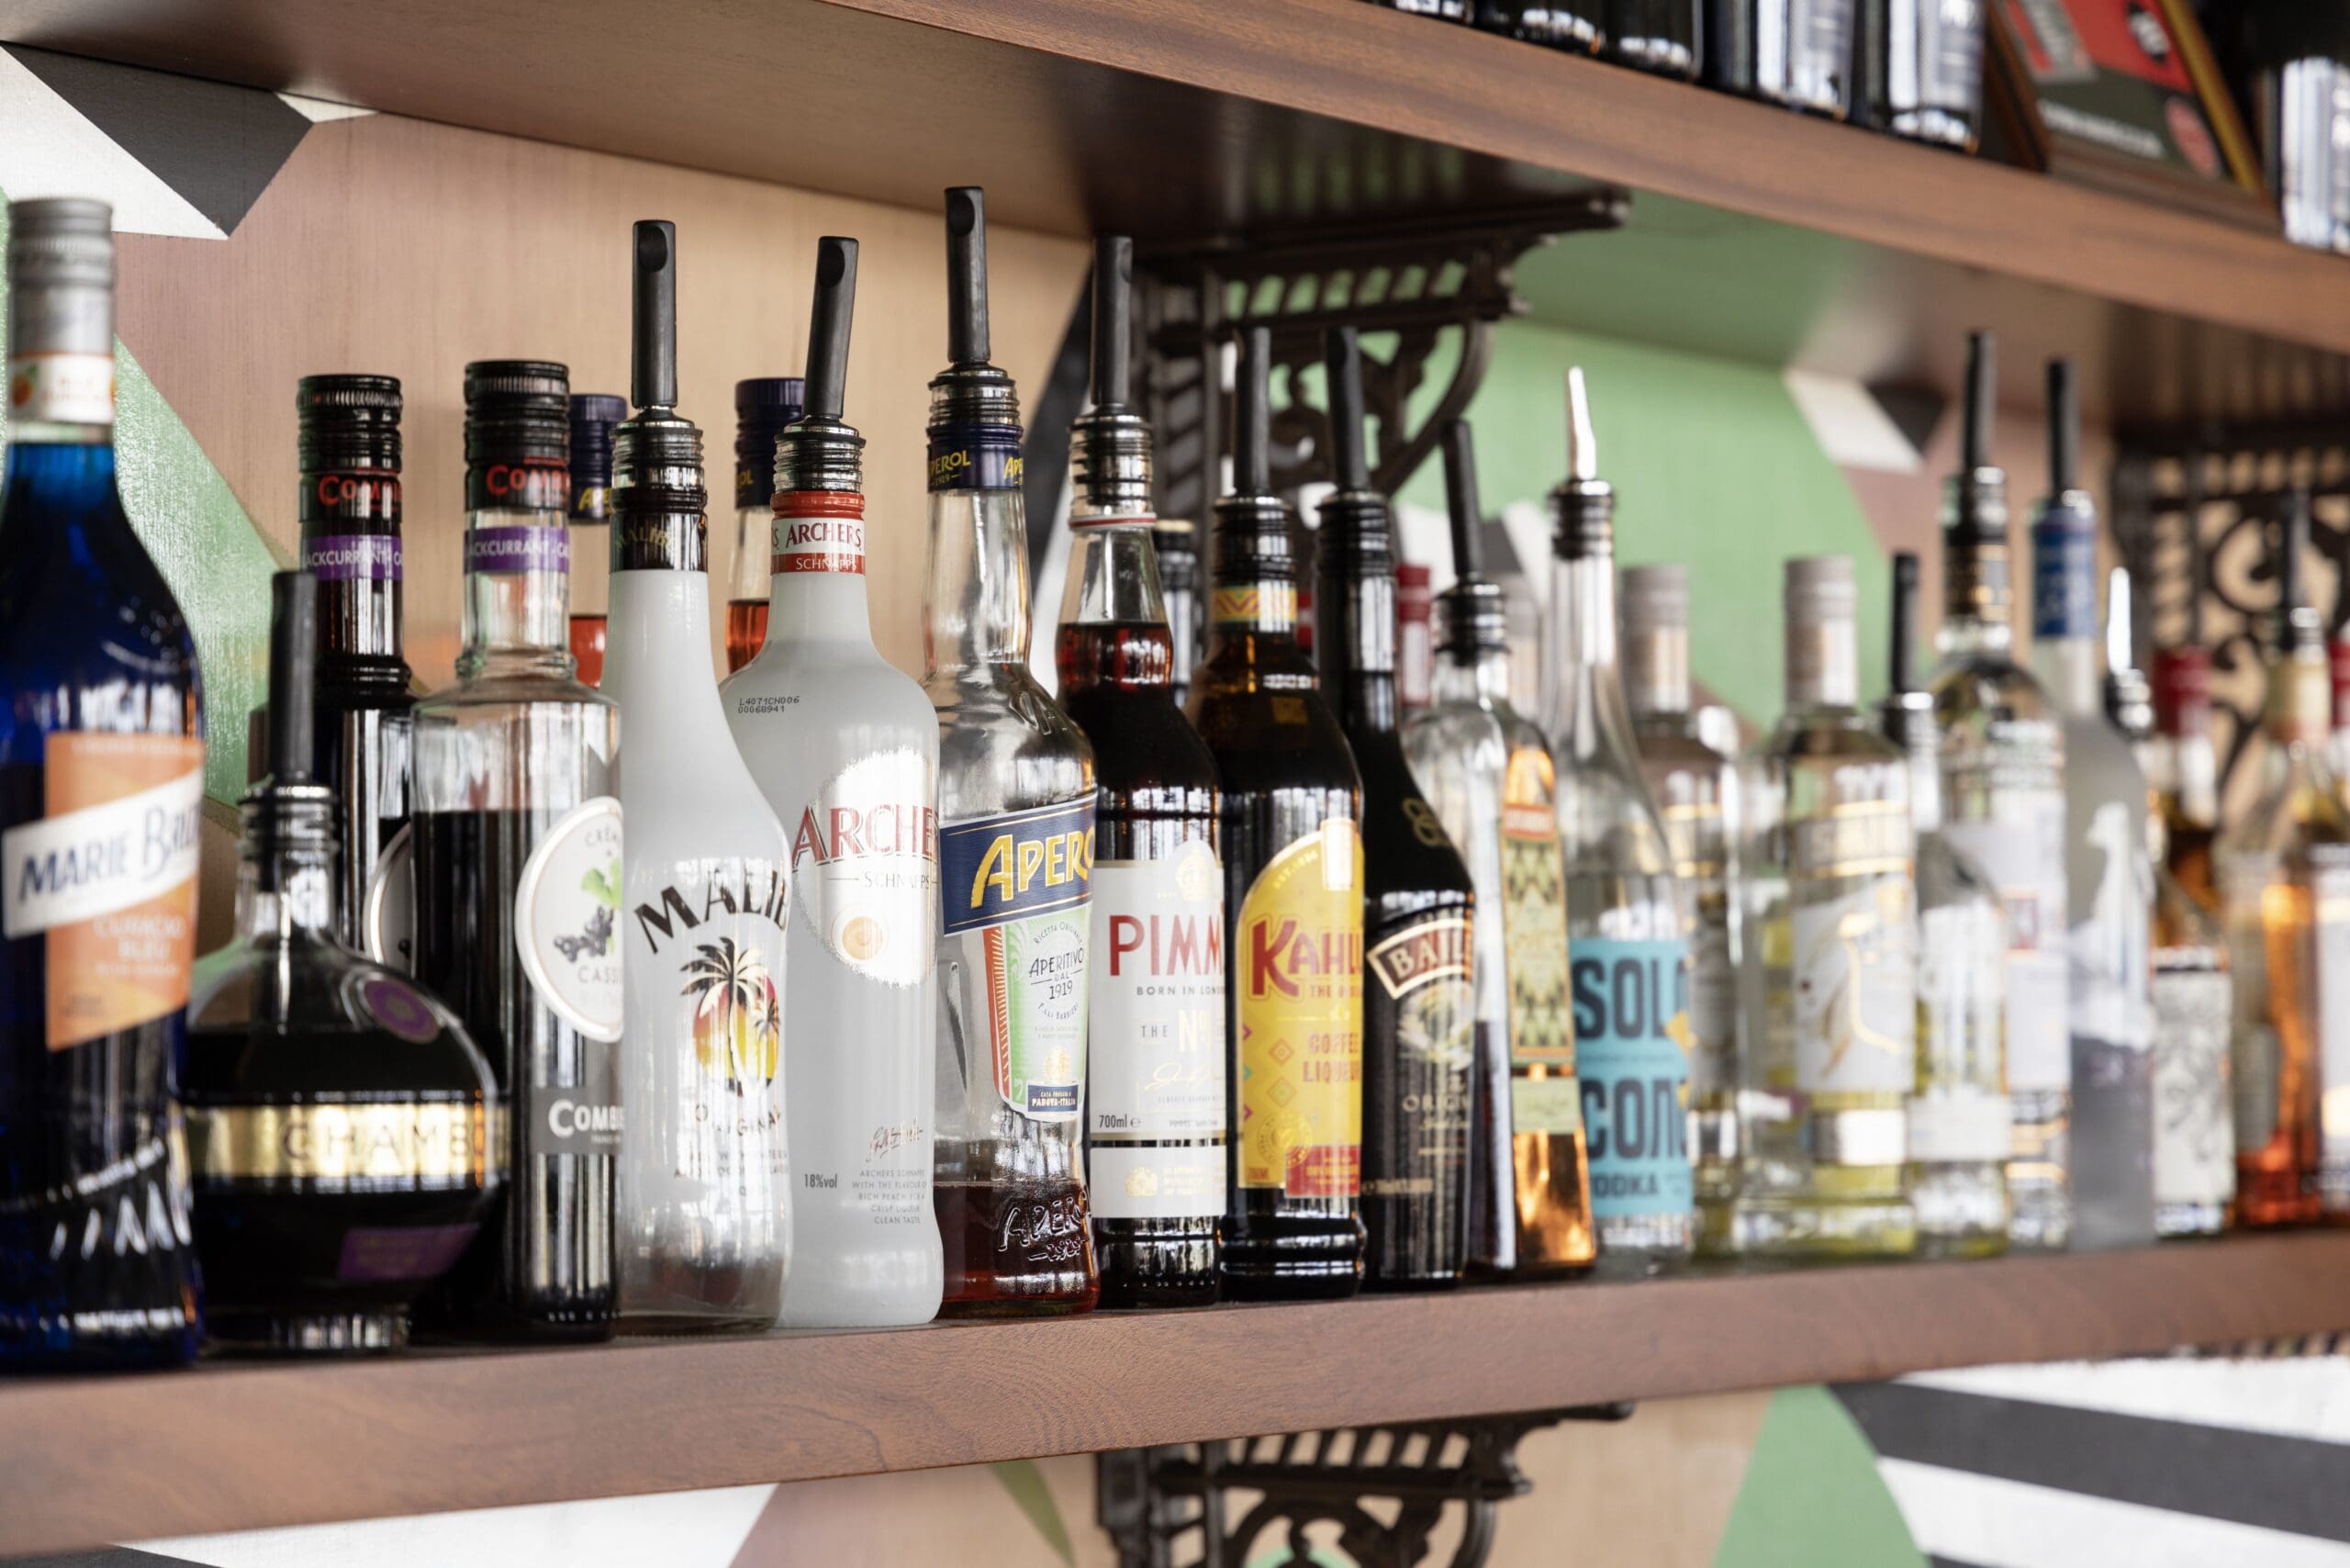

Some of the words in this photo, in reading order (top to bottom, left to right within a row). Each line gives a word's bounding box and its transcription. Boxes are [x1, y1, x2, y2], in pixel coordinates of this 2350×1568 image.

[785, 522, 861, 549] ARCHERS
[796, 556, 857, 571] SCHNAPPS
[737, 705, 785, 713] 00068941
[19, 833, 129, 904] MARIE
[1029, 947, 1084, 978] APERITIVO
[1054, 973, 1069, 981] DAL
[1049, 980, 1073, 1000] 1919
[1136, 986, 1176, 996] BORN
[1182, 987, 1195, 996] IN
[1141, 1025, 1168, 1037] THE
[1099, 1114, 1127, 1128] 700ml
[804, 1173, 837, 1189] 18%vol
[852, 1181, 875, 1190] WITH
[878, 1181, 892, 1190] THE
[1592, 1175, 1657, 1199] ODKA
[858, 1192, 878, 1201] RICH
[874, 1215, 901, 1224] CLEAN
